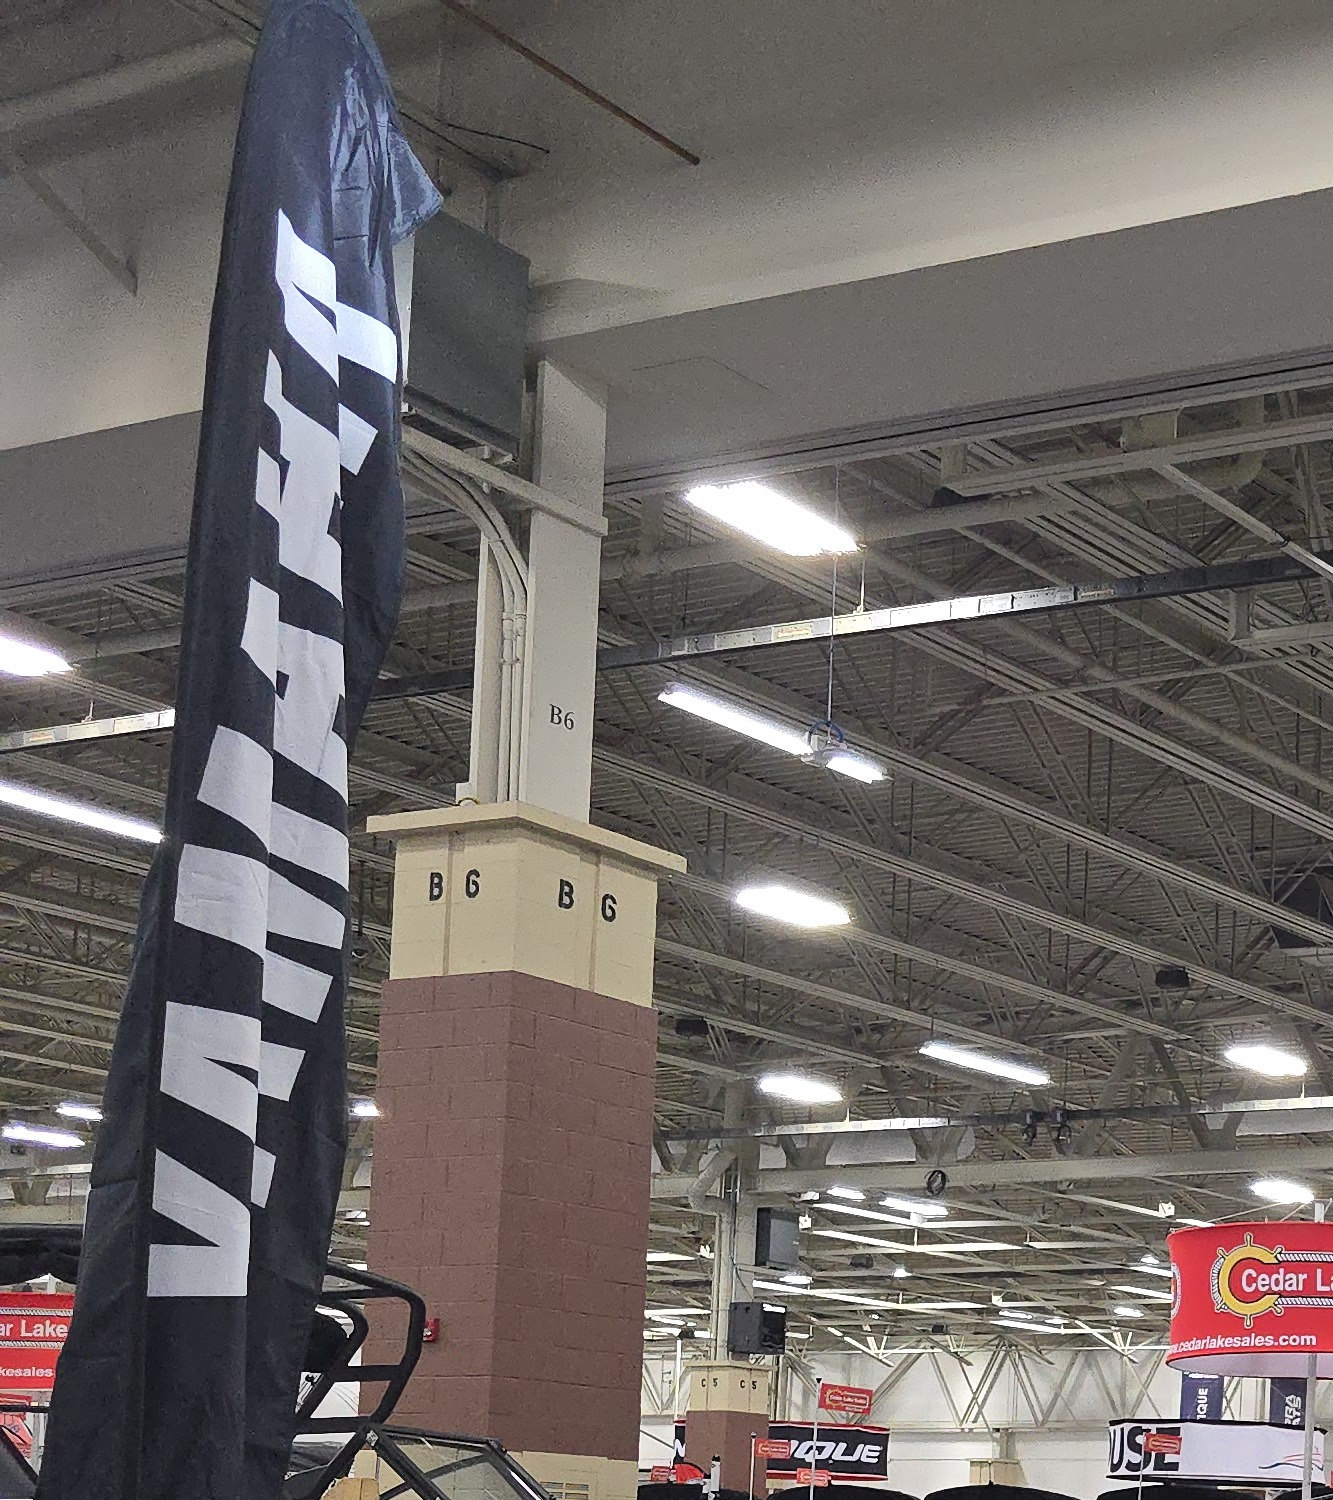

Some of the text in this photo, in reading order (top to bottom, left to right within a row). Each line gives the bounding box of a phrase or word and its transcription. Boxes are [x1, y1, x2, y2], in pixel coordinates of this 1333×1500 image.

[549, 704, 575, 730] B6
[429, 869, 480, 901] B 6
[558, 879, 617, 922] B 6
[1241, 1268, 1308, 1293] Cedar
[20, 1319, 69, 1338] Lake
